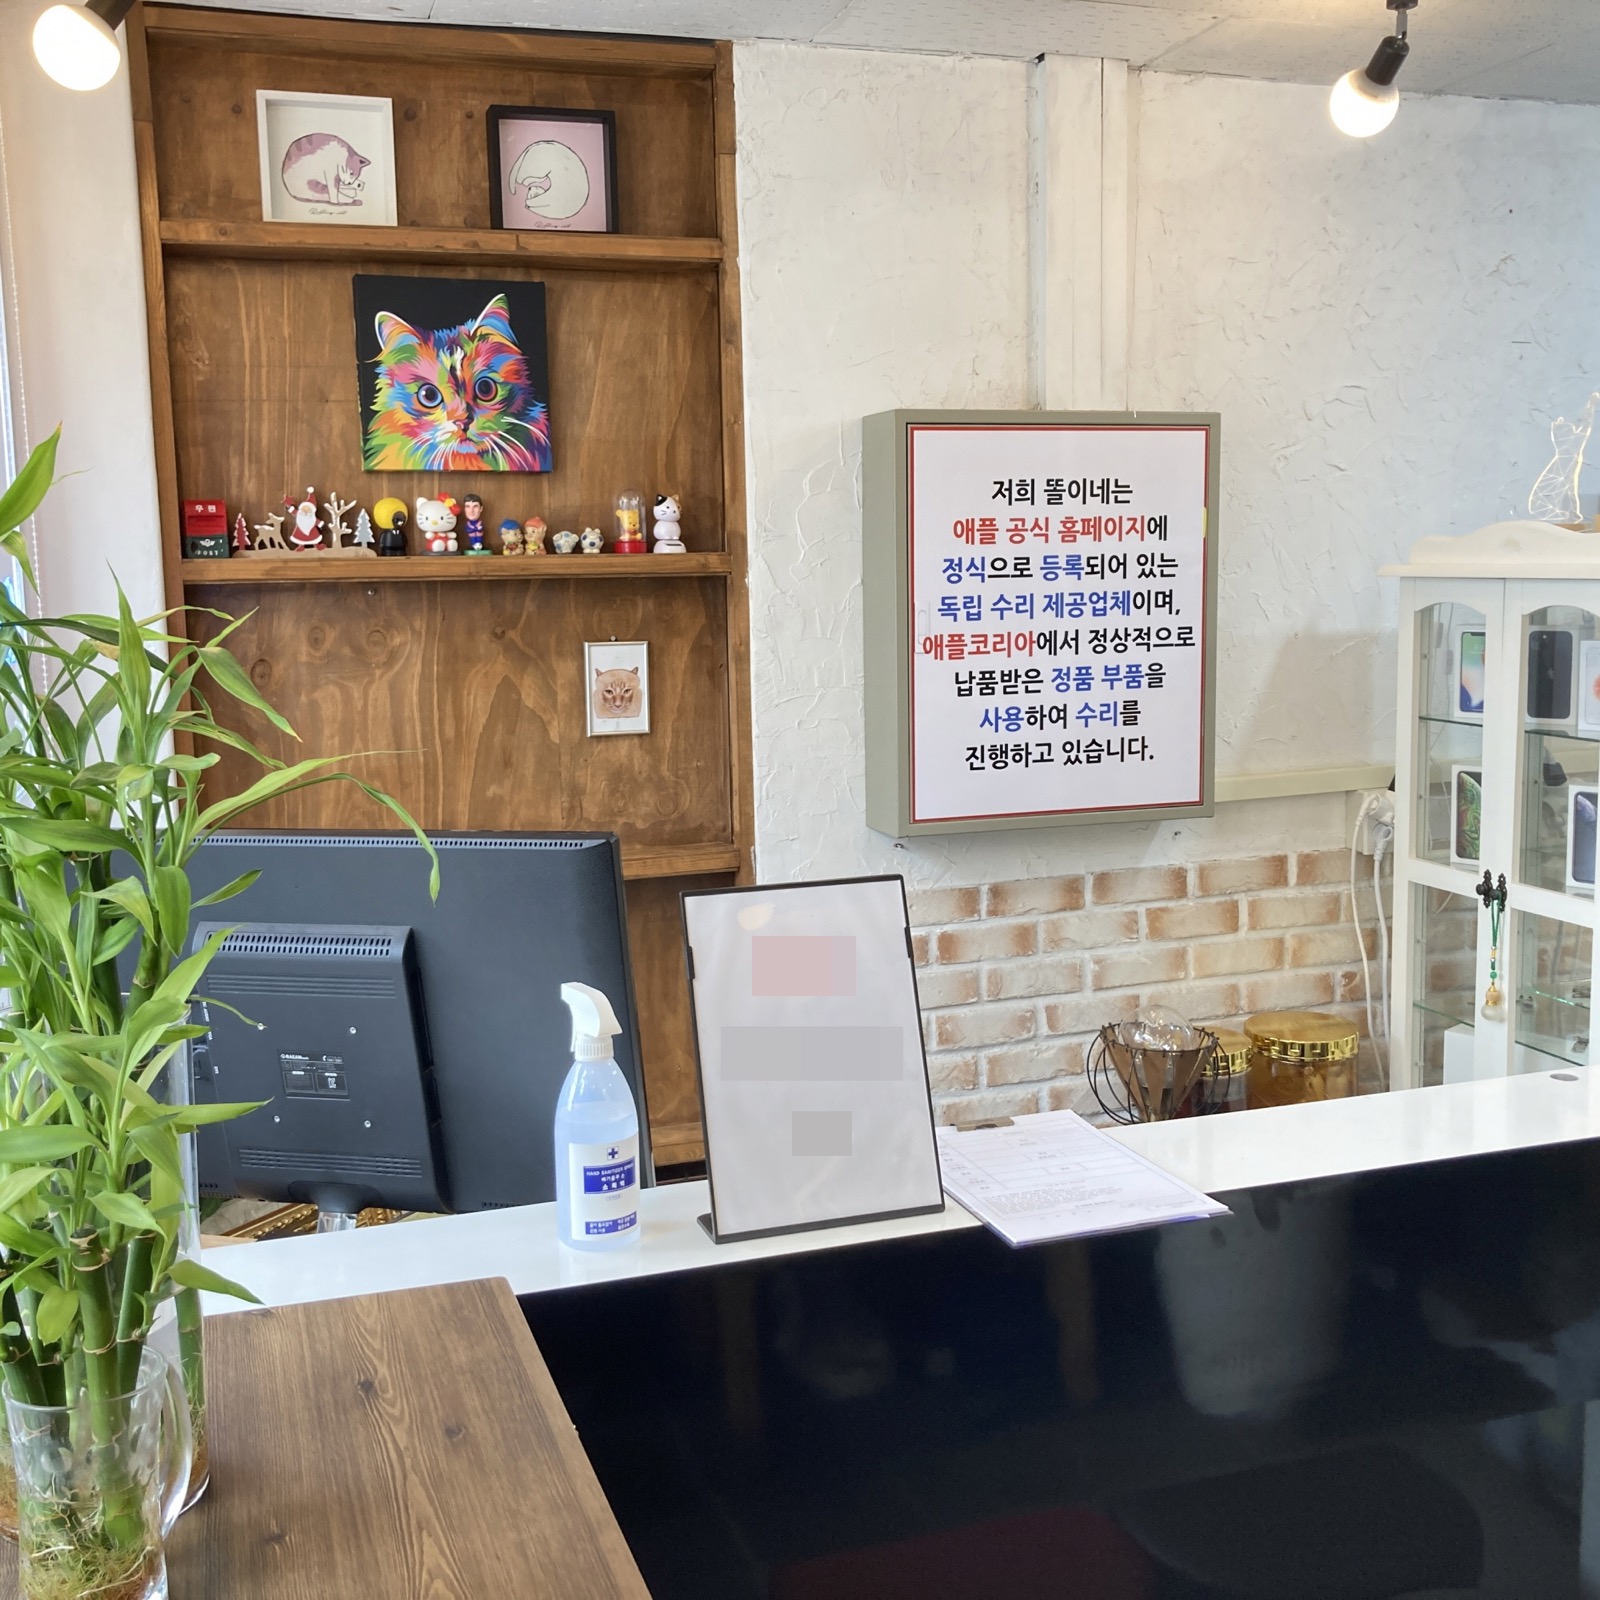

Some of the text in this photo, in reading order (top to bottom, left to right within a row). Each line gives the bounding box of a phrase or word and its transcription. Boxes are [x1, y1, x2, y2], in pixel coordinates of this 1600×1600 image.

[992, 478, 1134, 506] 저희 똘이네는
[953, 515, 1168, 545] 애플 공식 홈페이지에
[942, 553, 1179, 584] 정식으로 등록되어 있는
[938, 589, 1181, 622] 독립 수리 제공업체이며,
[922, 626, 1196, 660] 애플코리아에서 정상적으로
[954, 662, 1167, 697] 납품받은 정품 부품을
[979, 700, 1142, 733] 사용하여 수리를
[965, 736, 1155, 770] 진행하고 있습니다.
